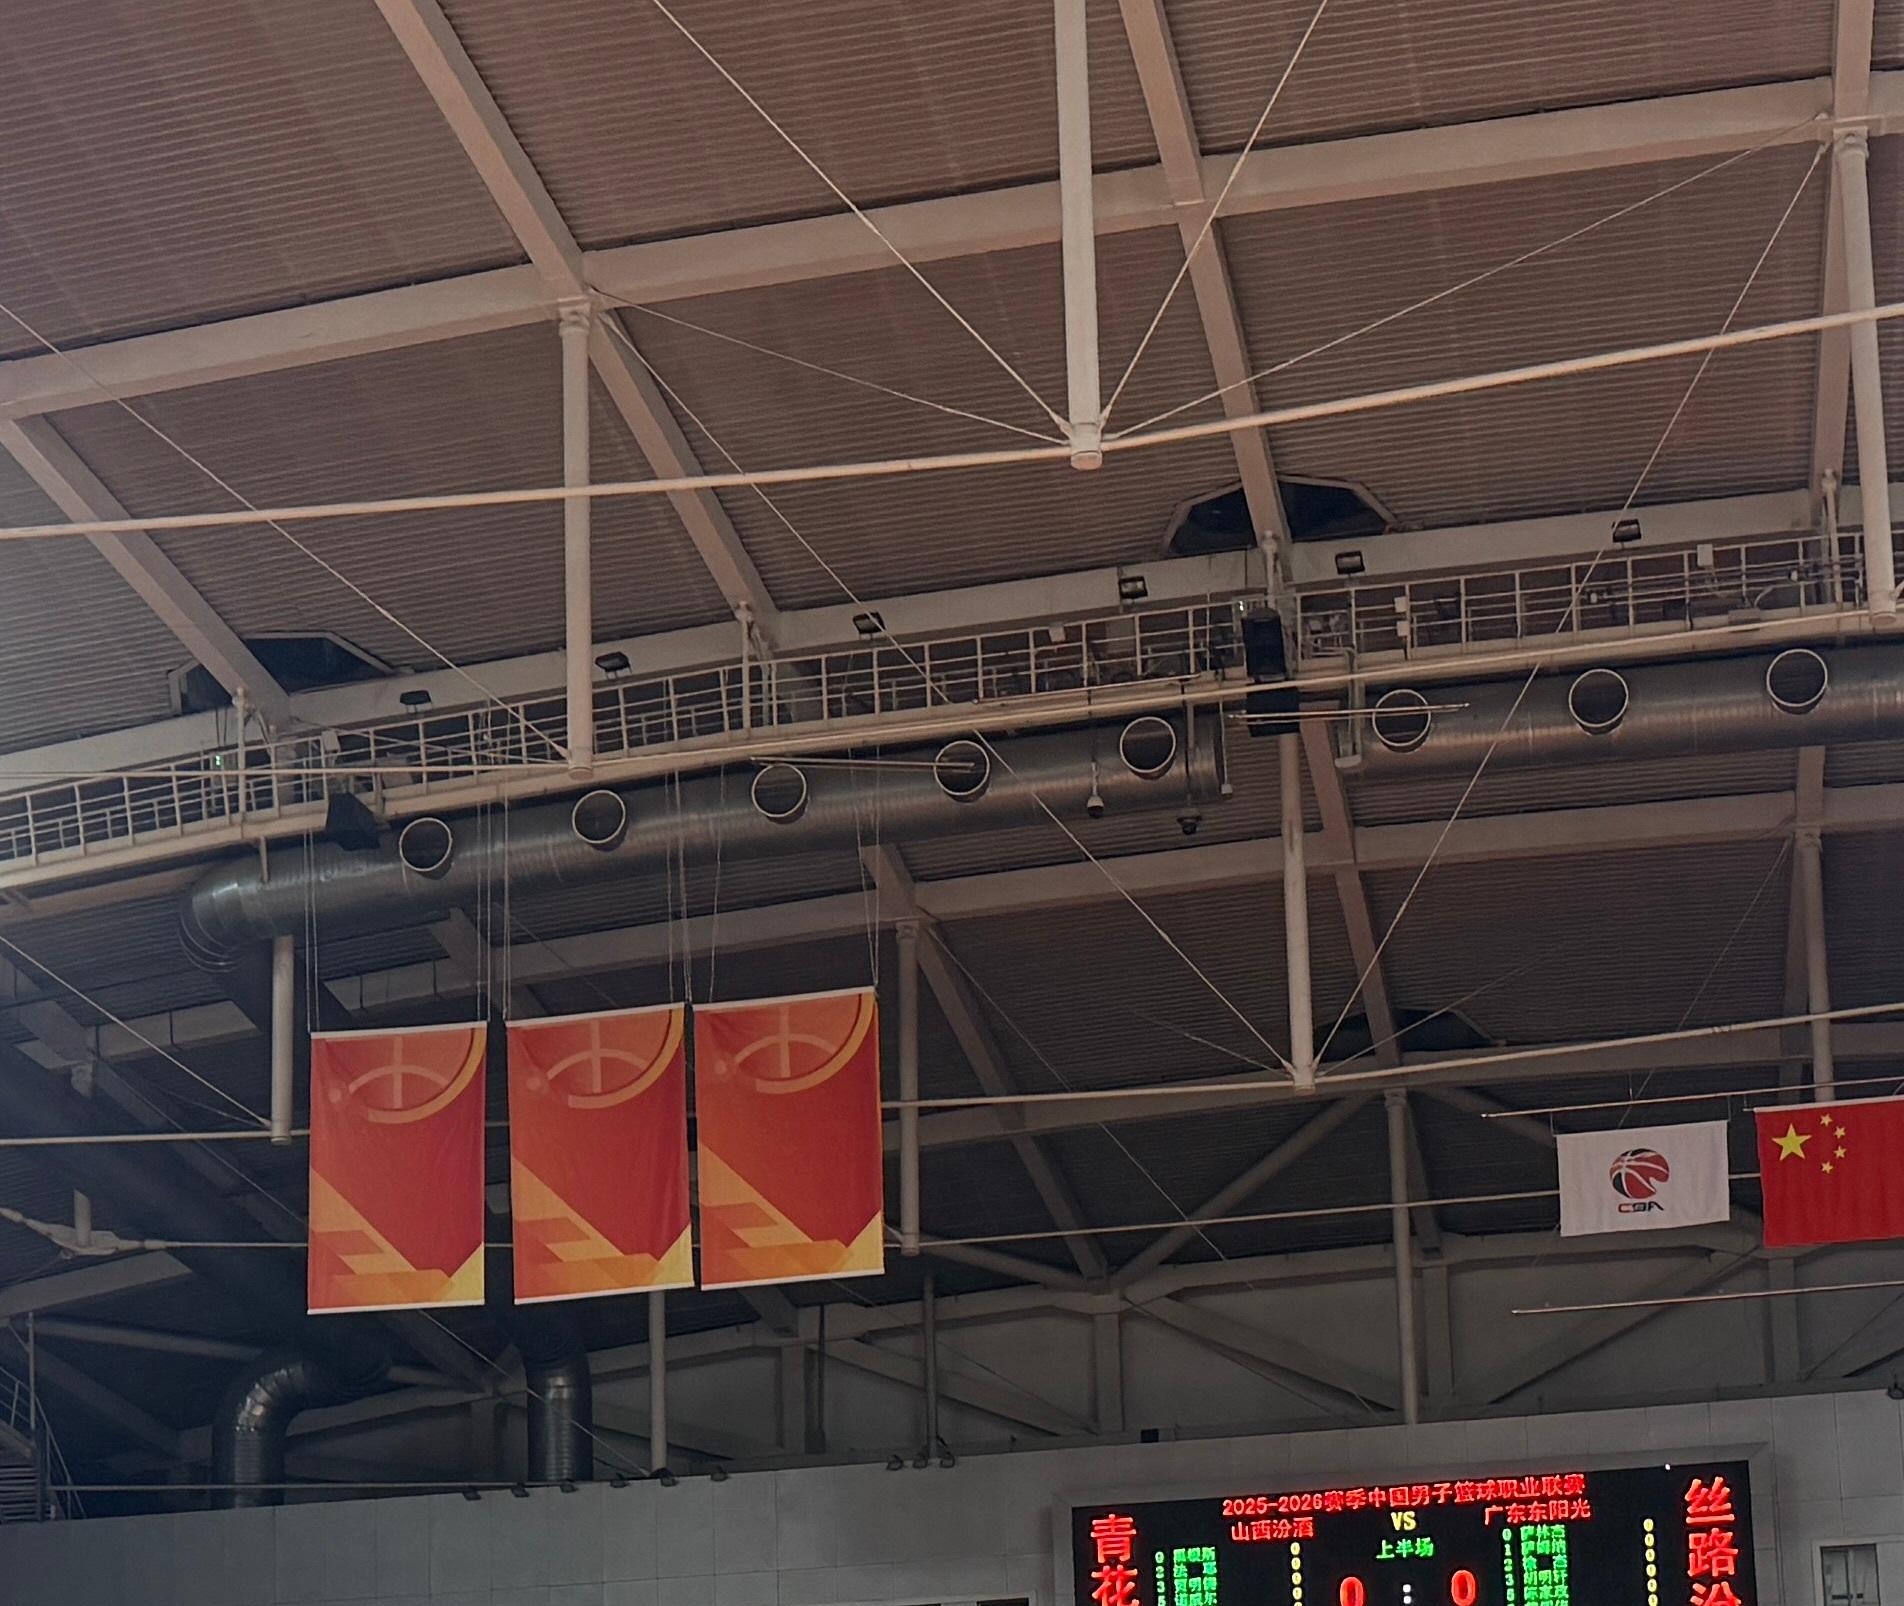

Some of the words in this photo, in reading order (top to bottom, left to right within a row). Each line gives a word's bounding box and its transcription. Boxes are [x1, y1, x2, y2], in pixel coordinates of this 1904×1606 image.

[1222, 1473, 1586, 1517] 2025-2026赛季中国男子篮球职业联赛
[1484, 1501, 1592, 1526] 广东东阳光
[1390, 1511, 1417, 1532] VS
[1231, 1516, 1315, 1542] 山西汾酒
[1502, 1528, 1512, 1541] 0
[1375, 1537, 1436, 1559] 上半场
[1504, 1544, 1512, 1556] 1
[1504, 1559, 1513, 1571] 2
[1155, 1566, 1165, 1578] 2
[1505, 1574, 1514, 1586] 3
[1156, 1581, 1165, 1593] 3
[1451, 1569, 1476, 1606] 0
[1506, 1588, 1515, 1601] 5
